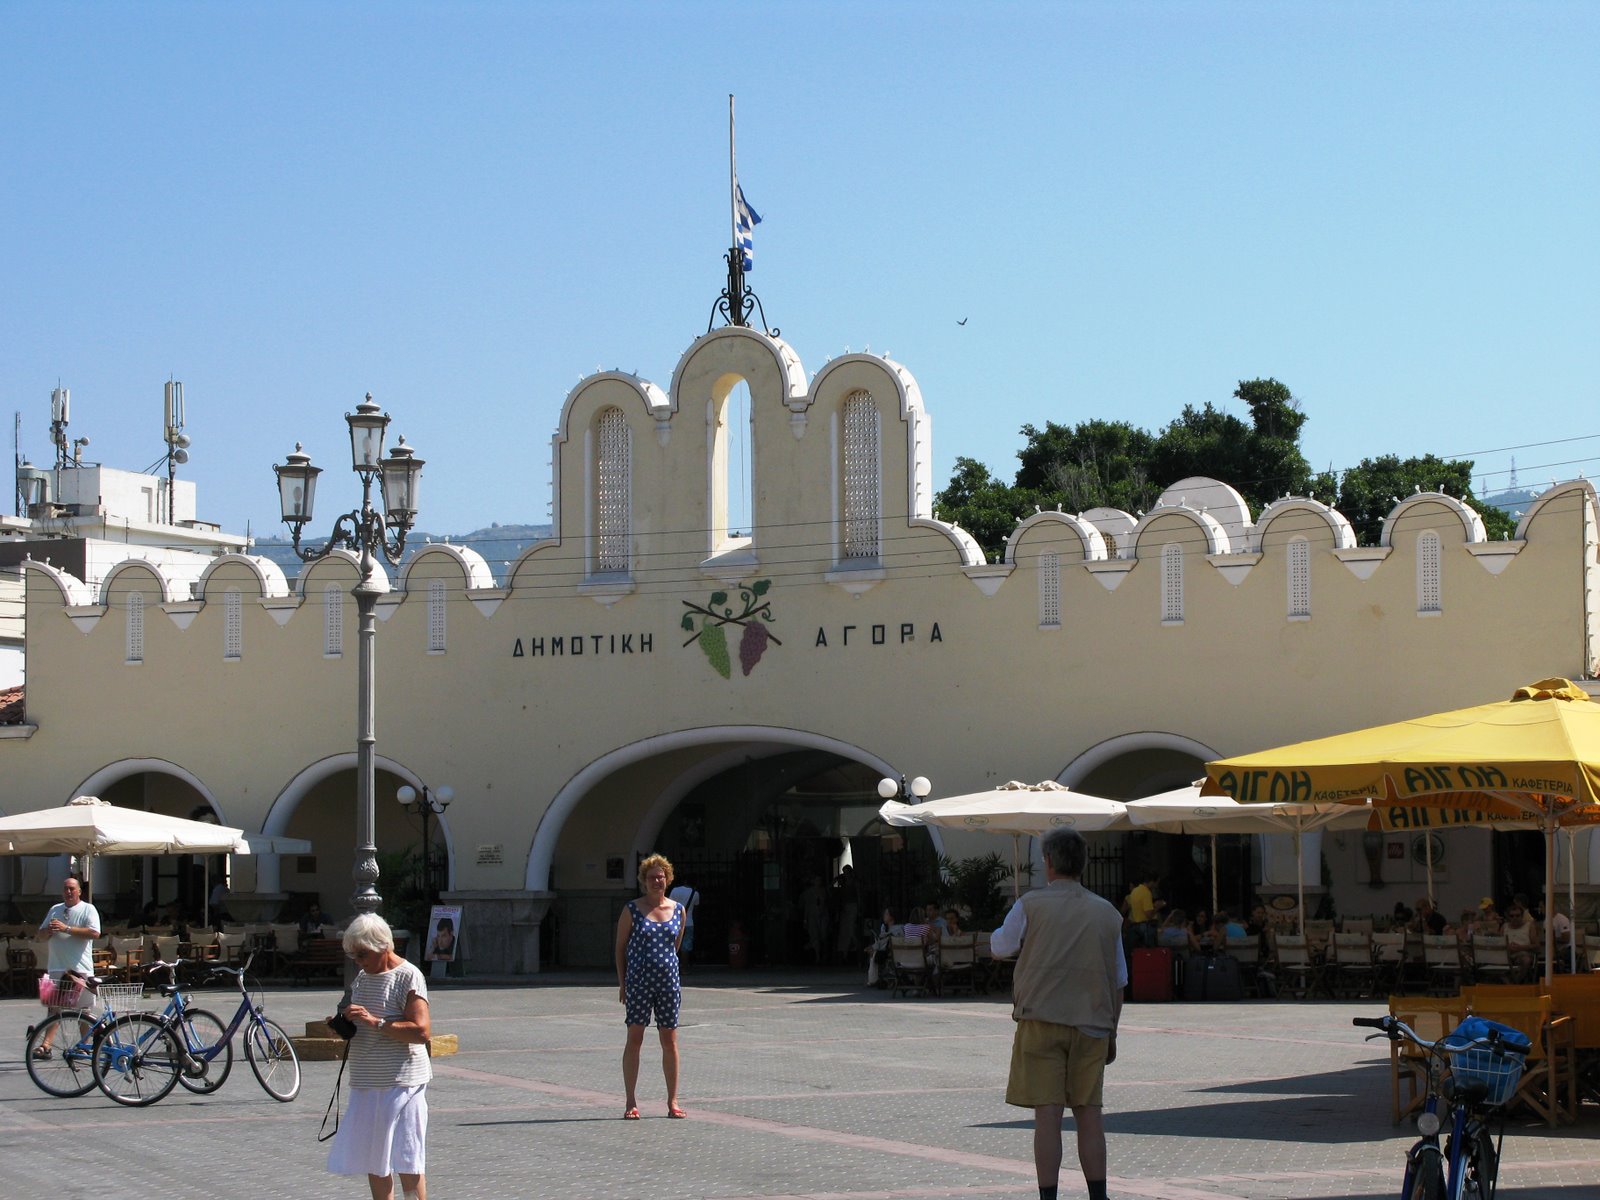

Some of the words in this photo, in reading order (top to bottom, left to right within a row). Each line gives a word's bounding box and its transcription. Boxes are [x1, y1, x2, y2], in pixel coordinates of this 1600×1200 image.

[513, 634, 653, 657] ΔΗΜΟΤΙΚΗ
[815, 622, 942, 647] ΑΓΟΡΑ
[1512, 778, 1573, 794] ΚΑΦΕΤΕΡΙΑ
